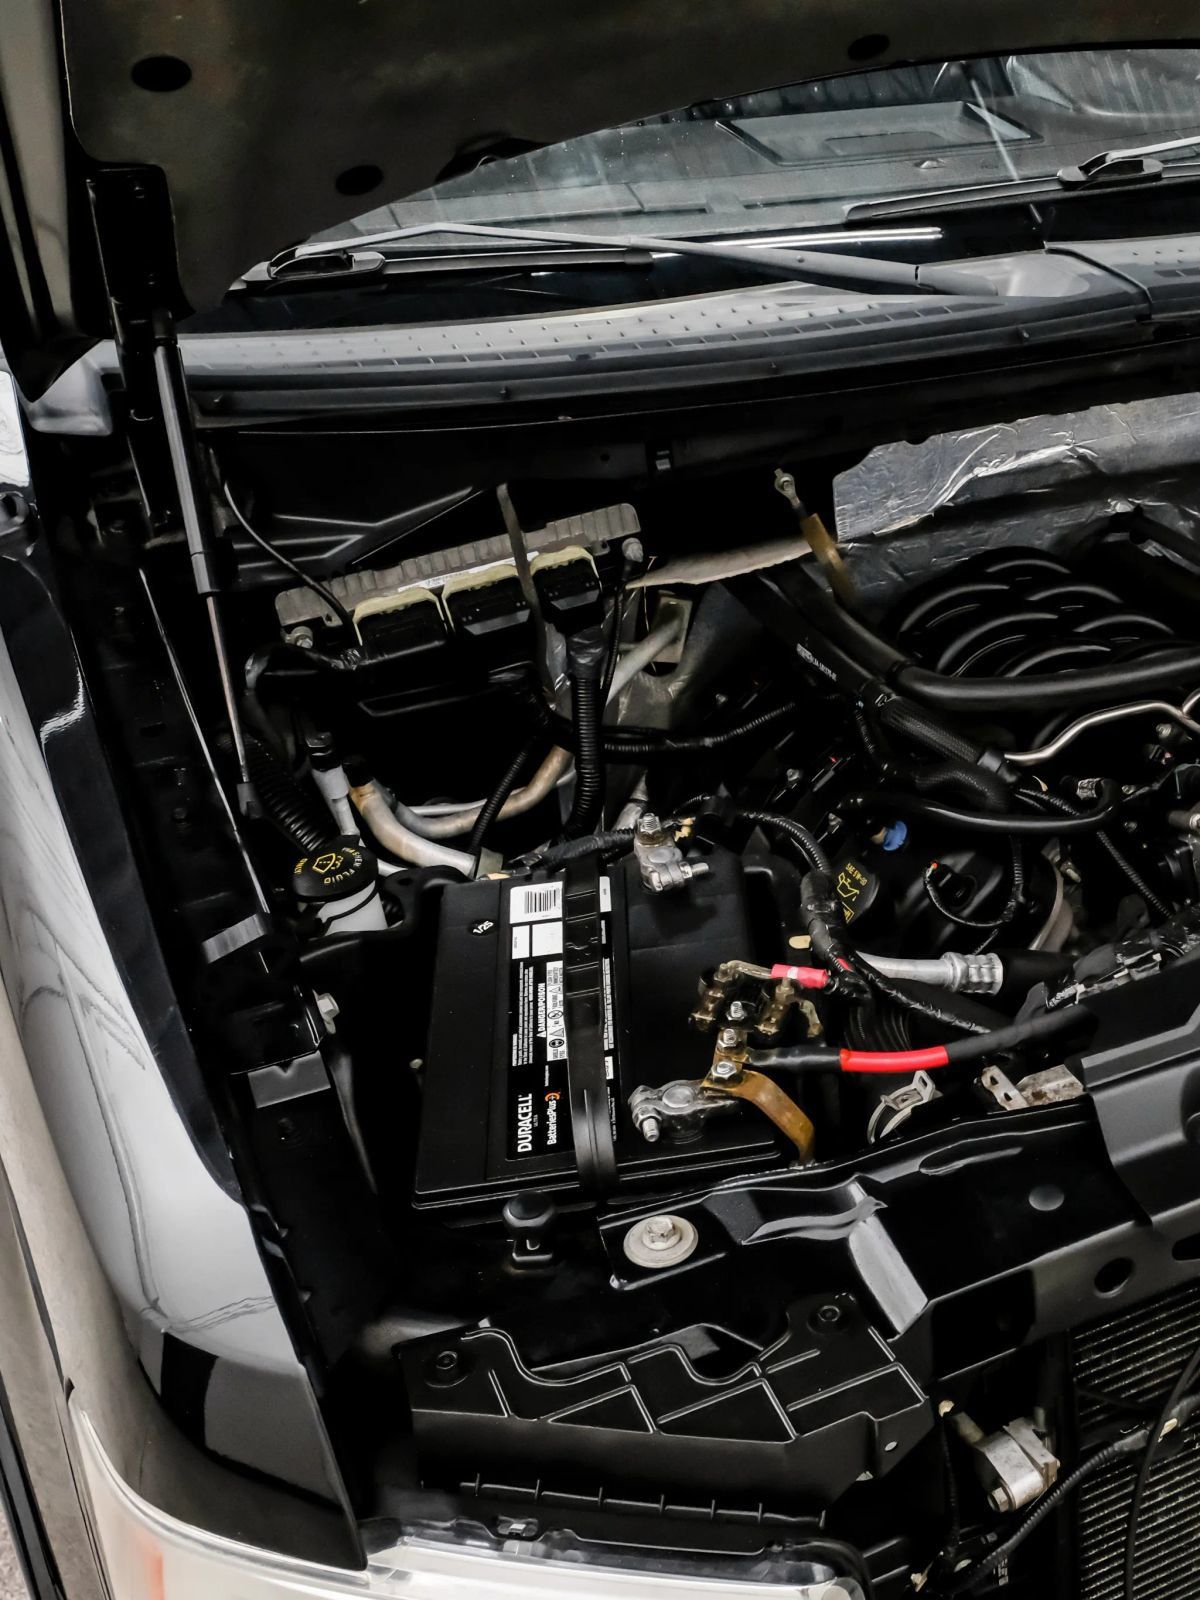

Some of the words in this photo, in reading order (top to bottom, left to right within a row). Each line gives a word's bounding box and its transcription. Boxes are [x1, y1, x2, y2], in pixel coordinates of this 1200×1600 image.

[324, 868, 356, 884] FLUID
[537, 982, 546, 1032] DANGER/POISON
[517, 1093, 533, 1153] DURACELL
